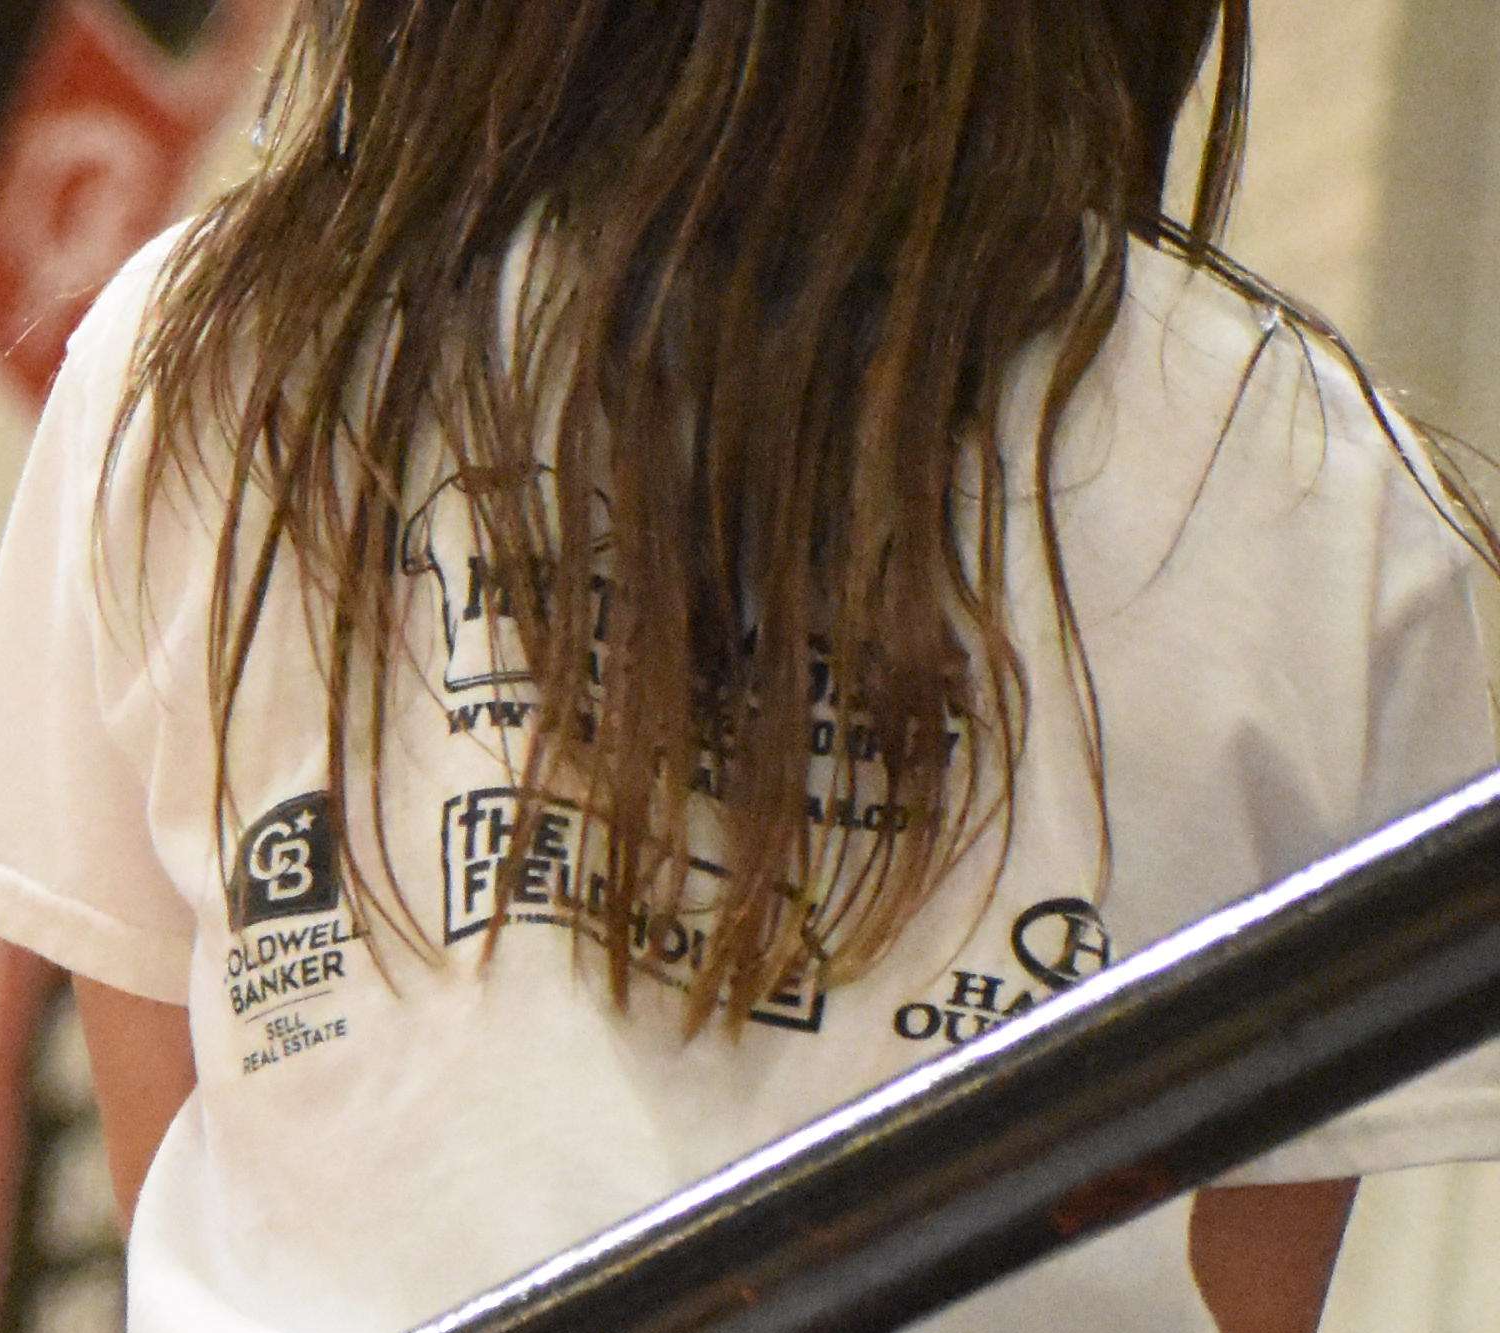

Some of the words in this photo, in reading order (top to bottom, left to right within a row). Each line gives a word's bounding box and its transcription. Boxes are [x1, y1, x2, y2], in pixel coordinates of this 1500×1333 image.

[459, 798, 570, 859] THE
[224, 918, 370, 984] OLDWELL
[229, 950, 345, 1015] BANKER
[243, 1047, 280, 1075] REAL
[283, 1018, 348, 1052] ESTATE
[265, 1011, 306, 1041] SELL
